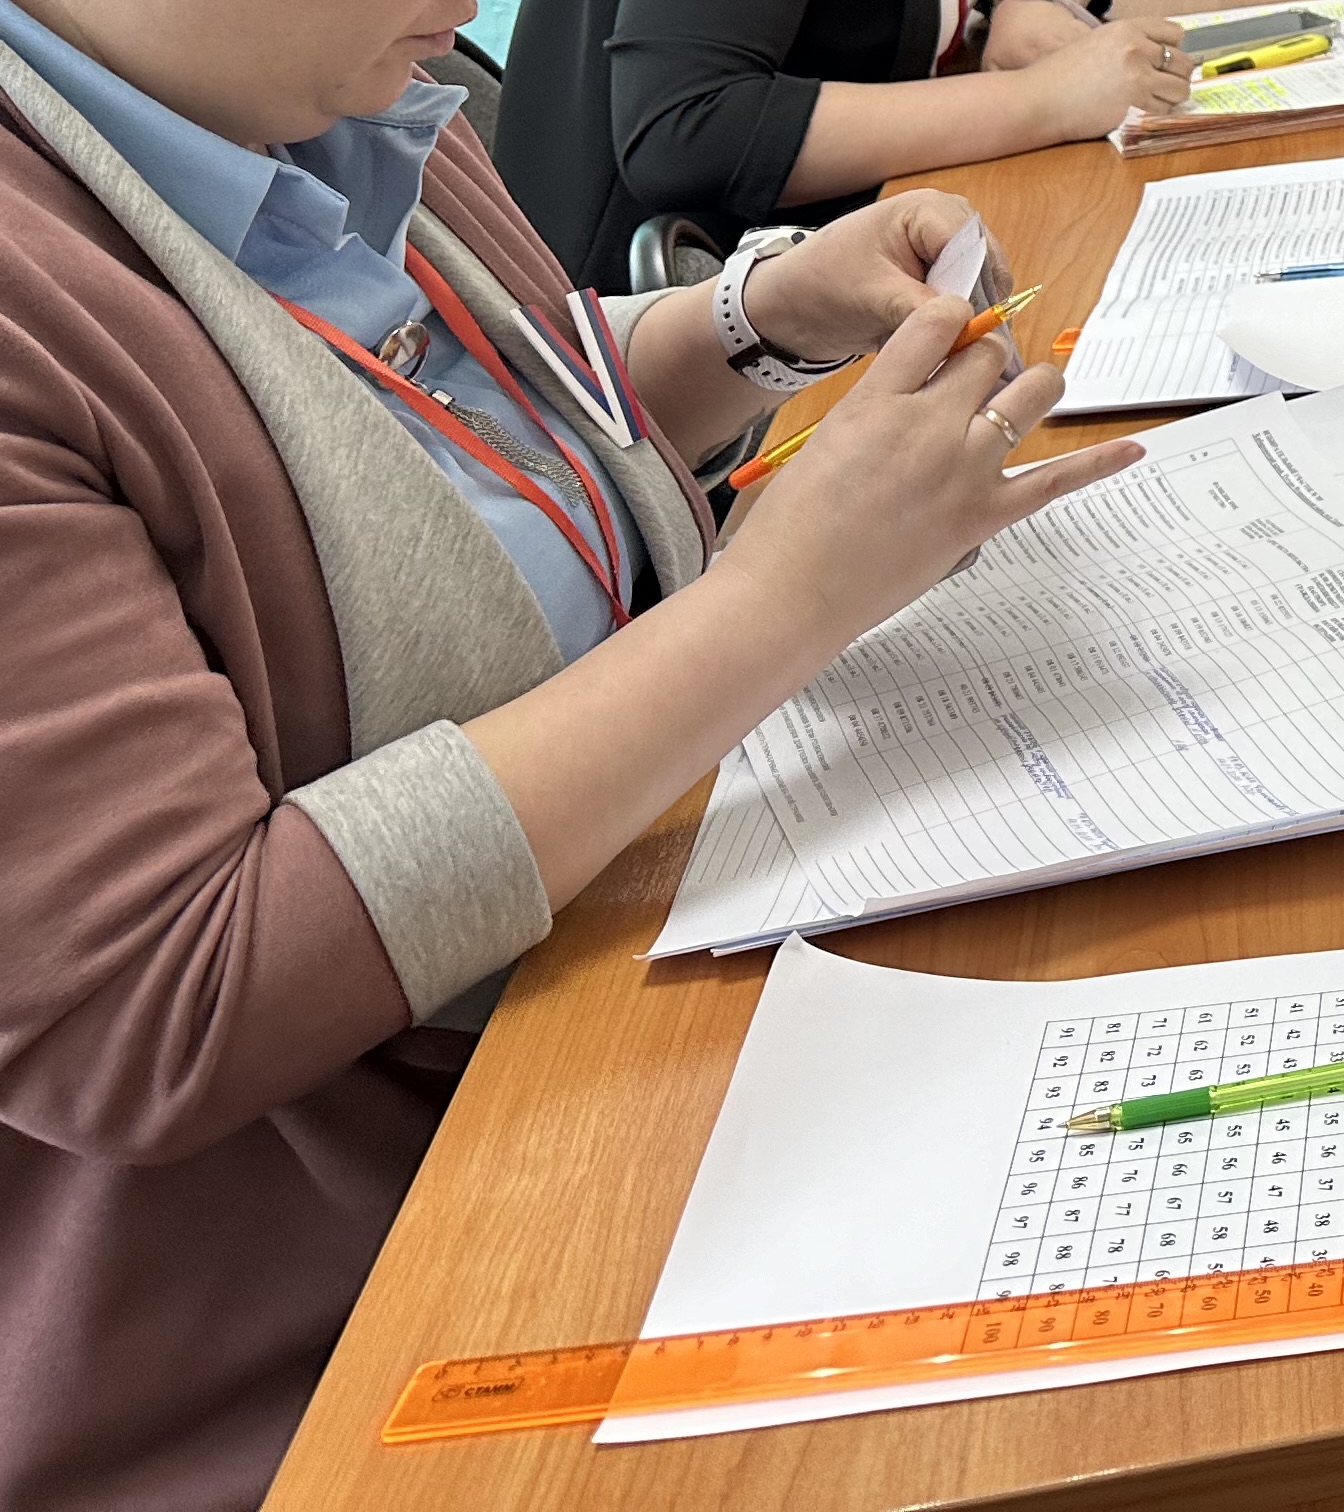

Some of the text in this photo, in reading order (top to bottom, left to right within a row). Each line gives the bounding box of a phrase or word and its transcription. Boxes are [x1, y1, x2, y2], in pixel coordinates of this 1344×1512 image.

[1324, 1112, 1339, 1126] 35
[1329, 1050, 1344, 1063] 33
[983, 1027, 1075, 1344] 91 92 93 94 95 96 97 98 100
[1038, 1022, 1122, 1333] 81 82 83 85 86 87 88 90
[1092, 1017, 1168, 1326] 71 72 73 75 76 77 78 80
[1147, 1012, 1213, 1318] 61 62 63 65 66 67 68 70
[1201, 1007, 1259, 1311] 51 52 53 55 56 57 58 60
[1254, 1002, 1304, 1304] 41 42 43 45 46 47 48 50
[1314, 1212, 1331, 1227] 38
[1318, 1178, 1333, 1191] 37
[1320, 1144, 1337, 1158] 36
[1308, 1282, 1324, 1297] 40
